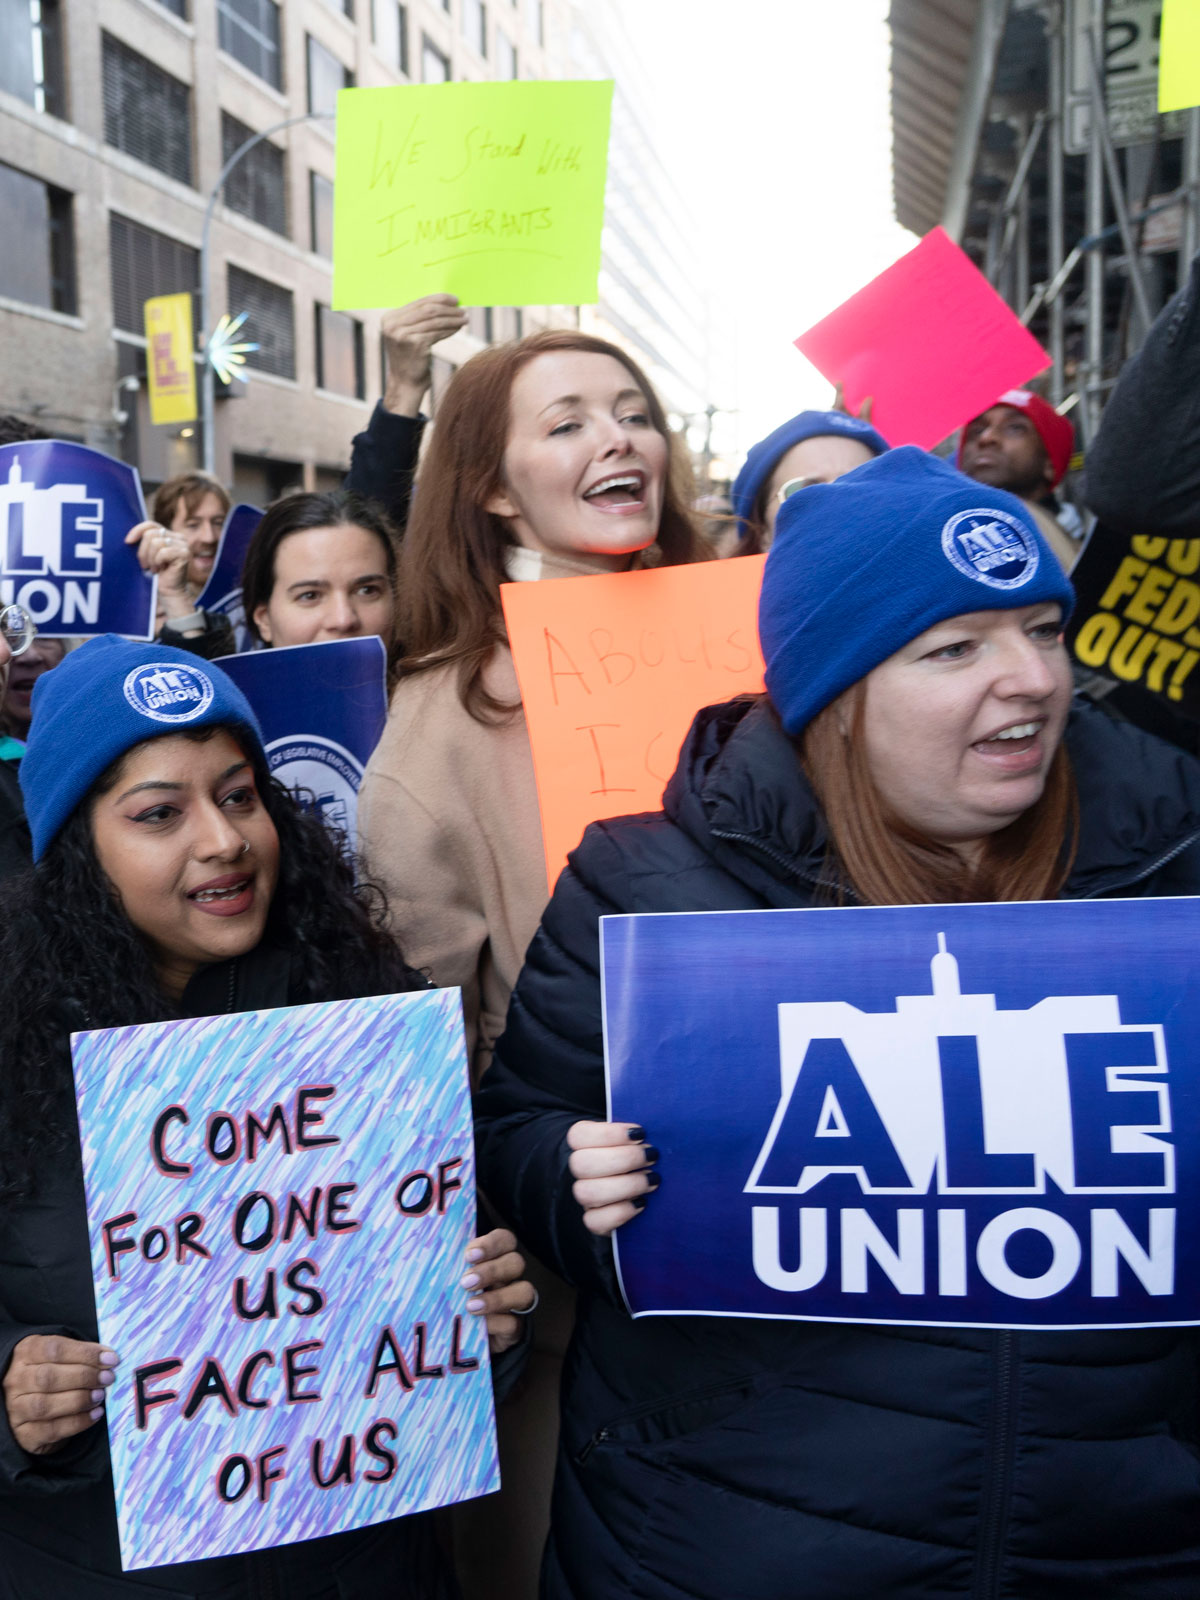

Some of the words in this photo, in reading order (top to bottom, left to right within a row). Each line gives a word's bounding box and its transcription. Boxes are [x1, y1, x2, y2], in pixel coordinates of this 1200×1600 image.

[1103, 15, 1162, 75] 2
[369, 113, 427, 190] WE
[440, 125, 527, 184] Stand
[375, 203, 553, 258] IMMIGRANTS
[957, 520, 1020, 562] ALE
[0, 578, 101, 625] ION
[139, 669, 197, 700] ALE
[543, 626, 753, 706] ABOLIS
[1074, 612, 1200, 701] OUT!
[146, 687, 201, 709] UNION
[575, 724, 668, 797] IC
[150, 1083, 340, 1180] COME
[743, 1010, 1176, 1194] ALE
[232, 1181, 362, 1254] ONE
[394, 1157, 464, 1221] OF
[231, 1257, 328, 1322] US
[751, 1206, 1176, 1300] UNION
[133, 1339, 324, 1431] FACE
[364, 1314, 481, 1399] ALL
[216, 1445, 288, 1504] OF
[309, 1416, 400, 1491] US
